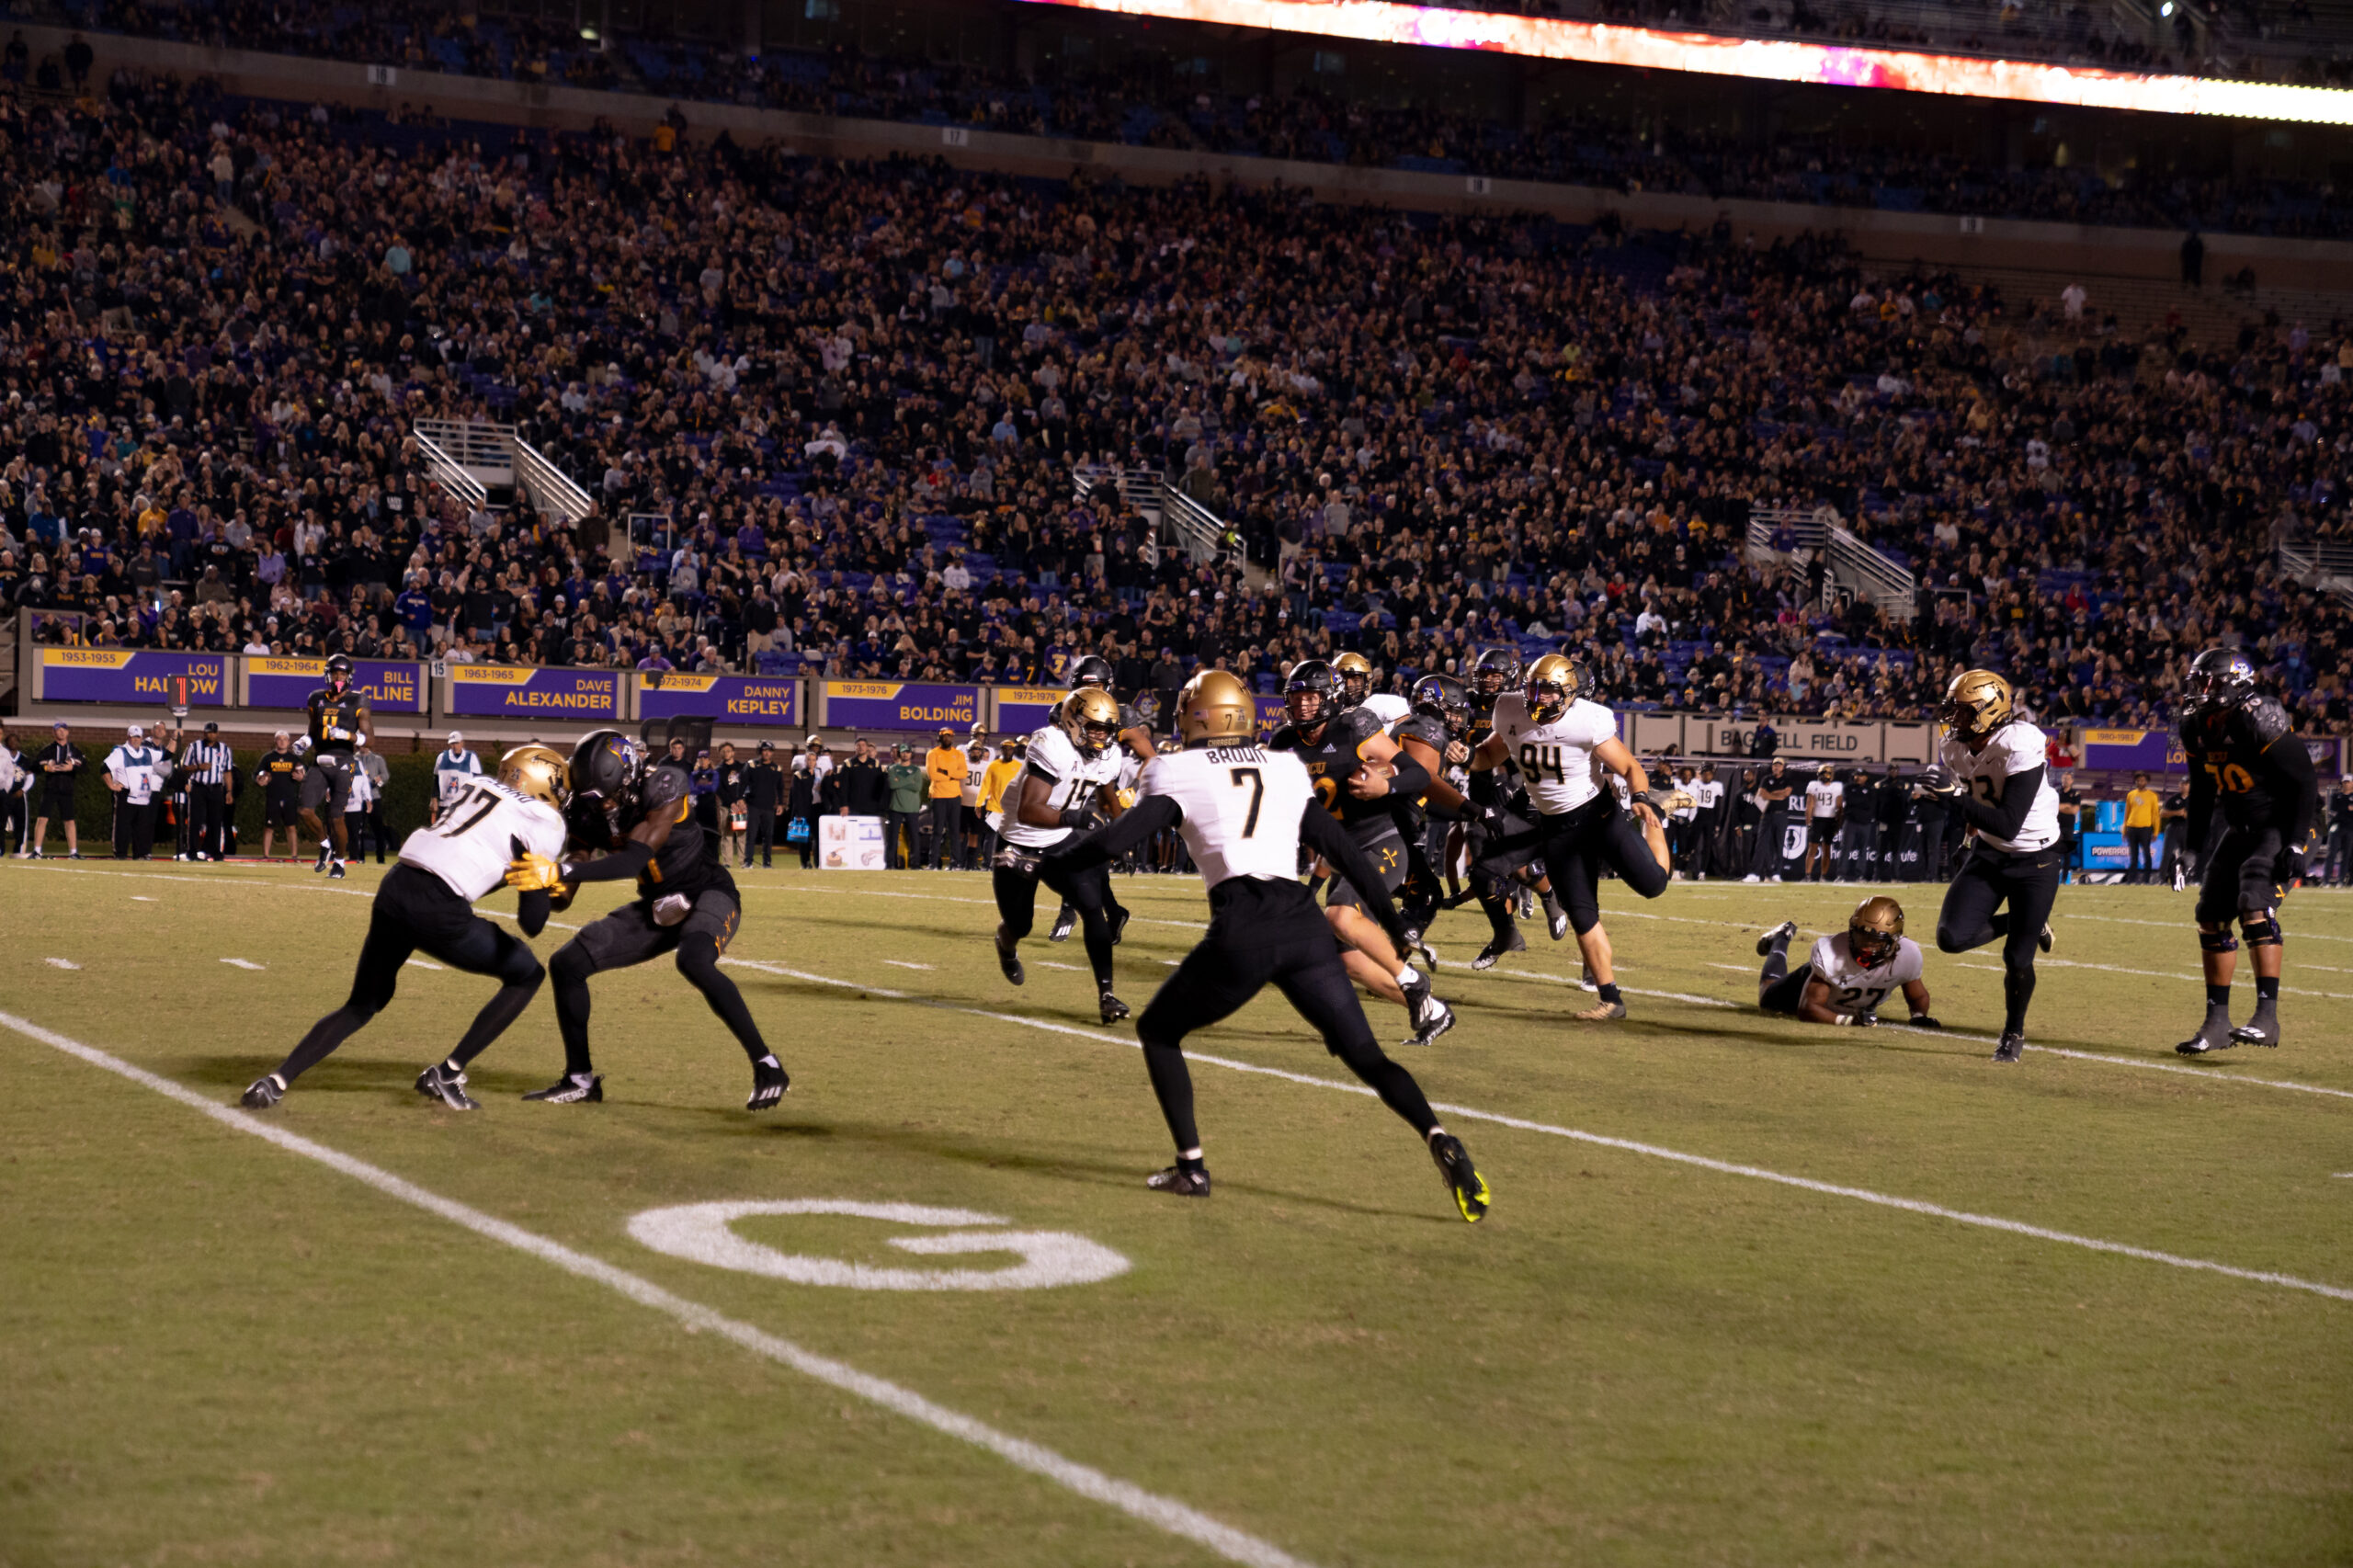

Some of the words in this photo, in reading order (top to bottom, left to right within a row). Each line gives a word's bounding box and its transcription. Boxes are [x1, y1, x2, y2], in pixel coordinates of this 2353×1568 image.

[949, 130, 961, 143] 17
[61, 652, 116, 663] 1953-1955
[188, 664, 219, 676] LOU
[266, 660, 319, 671] 1962-1964
[434, 663, 445, 675] 15
[383, 671, 414, 684] BILL
[464, 668, 515, 679] 1963-1965
[1027, 665, 1035, 682] 7
[576, 679, 612, 692] DAVE
[660, 676, 702, 687] 972-1974
[744, 686, 790, 699] DANNY
[841, 684, 888, 695] 1973-1976
[1013, 691, 1057, 701] 1973-1976
[505, 691, 612, 709] ALEXANDER
[727, 699, 790, 715] KEPLEY
[952, 695, 973, 707] JIM
[899, 706, 973, 722] BOLDING
[1225, 713, 1233, 731] 7
[1721, 731, 1802, 749] BAGELL
[1811, 733, 1858, 751] FIELD
[1519, 743, 1565, 785] 94
[965, 771, 981, 786] 30
[2204, 763, 2255, 793] 70
[1061, 778, 1097, 811] 15
[1700, 789, 1712, 803] 19
[1818, 792, 1833, 806] 43
[1230, 767, 1264, 838] 7
[1835, 988, 1886, 1011] 27
[627, 1199, 1133, 1290] G
